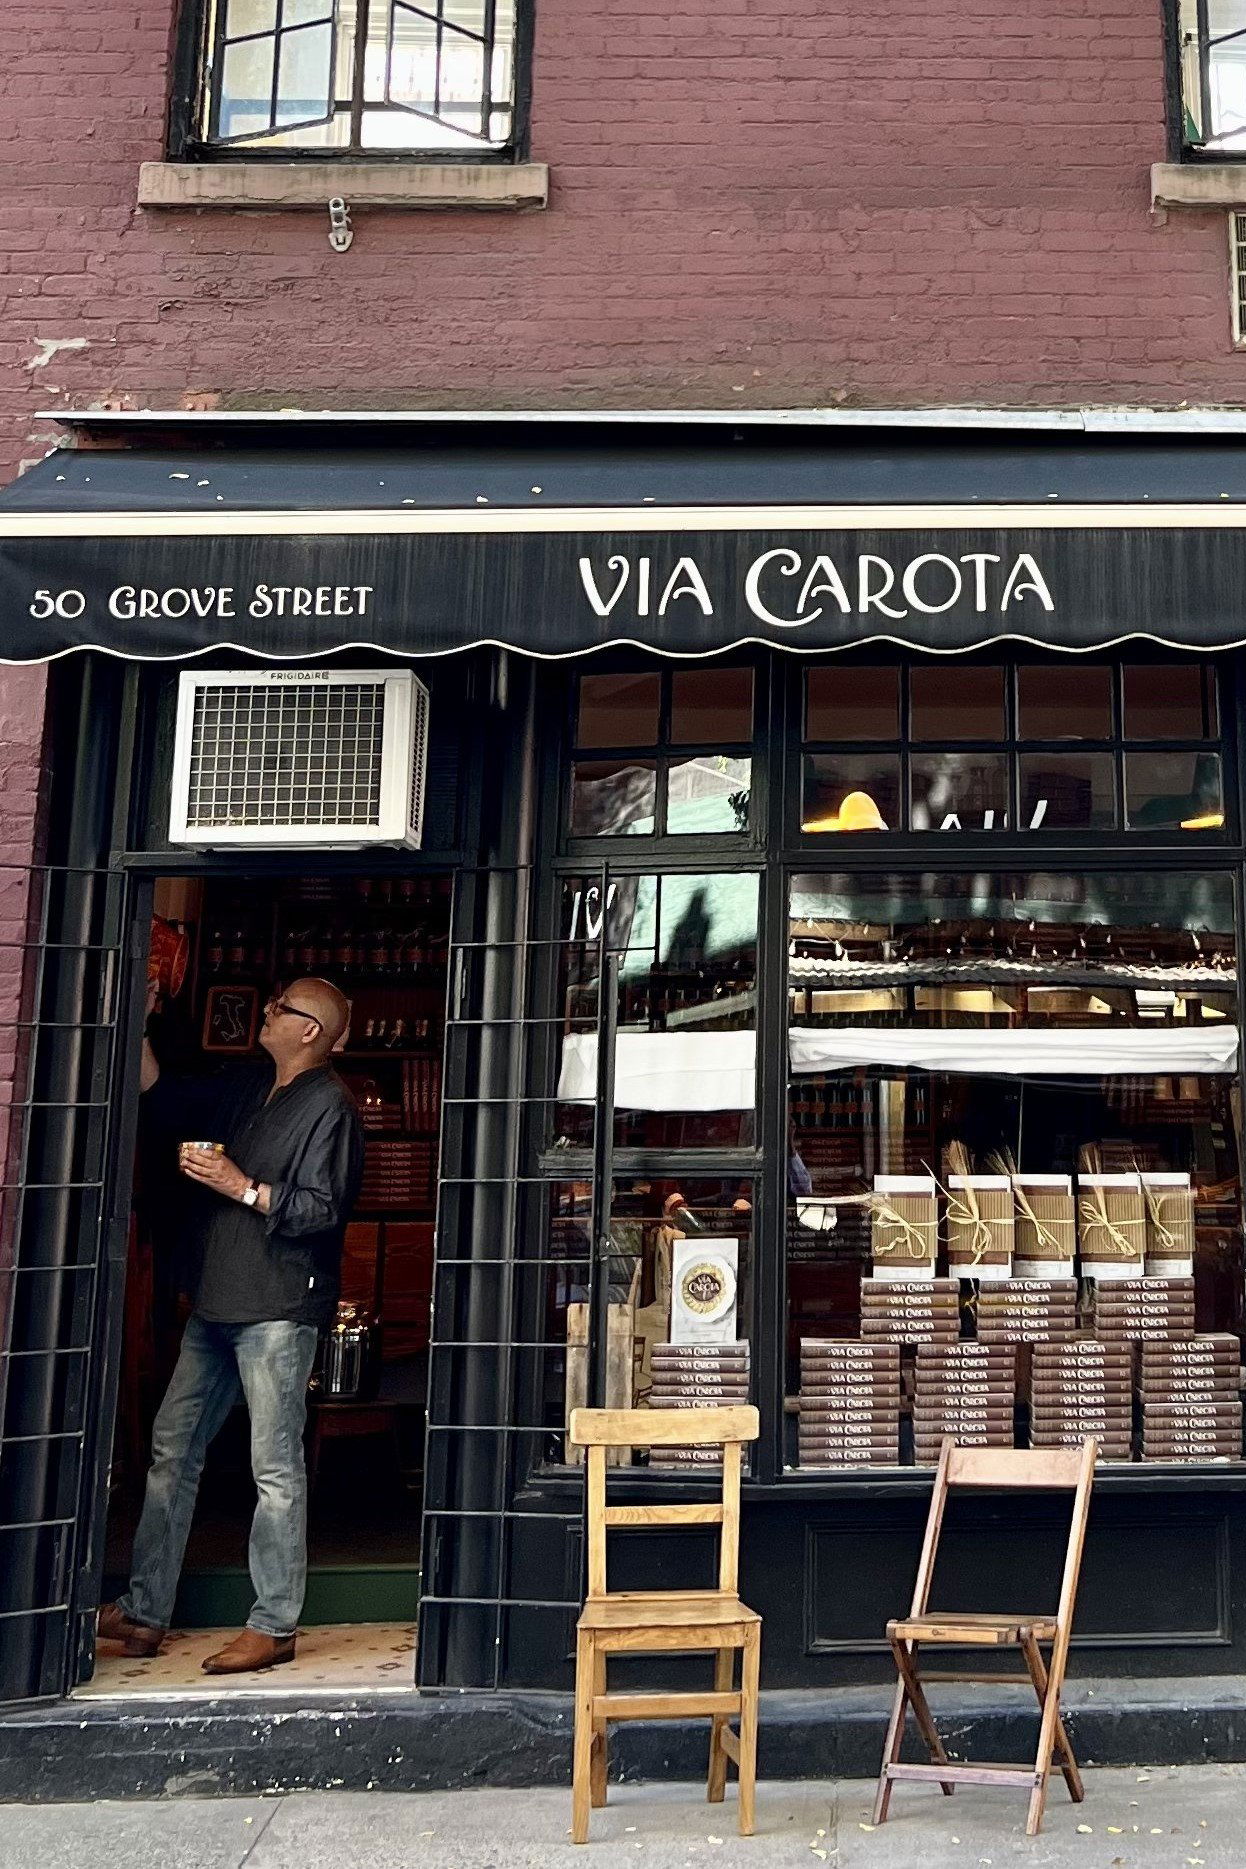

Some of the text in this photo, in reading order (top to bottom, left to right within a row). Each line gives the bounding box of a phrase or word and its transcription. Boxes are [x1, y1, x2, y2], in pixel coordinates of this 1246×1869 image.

[29, 584, 374, 619] 50 GROVE STREET
[579, 548, 1054, 627] VIA CAROTA
[270, 671, 330, 680] FRIGIDAIRE
